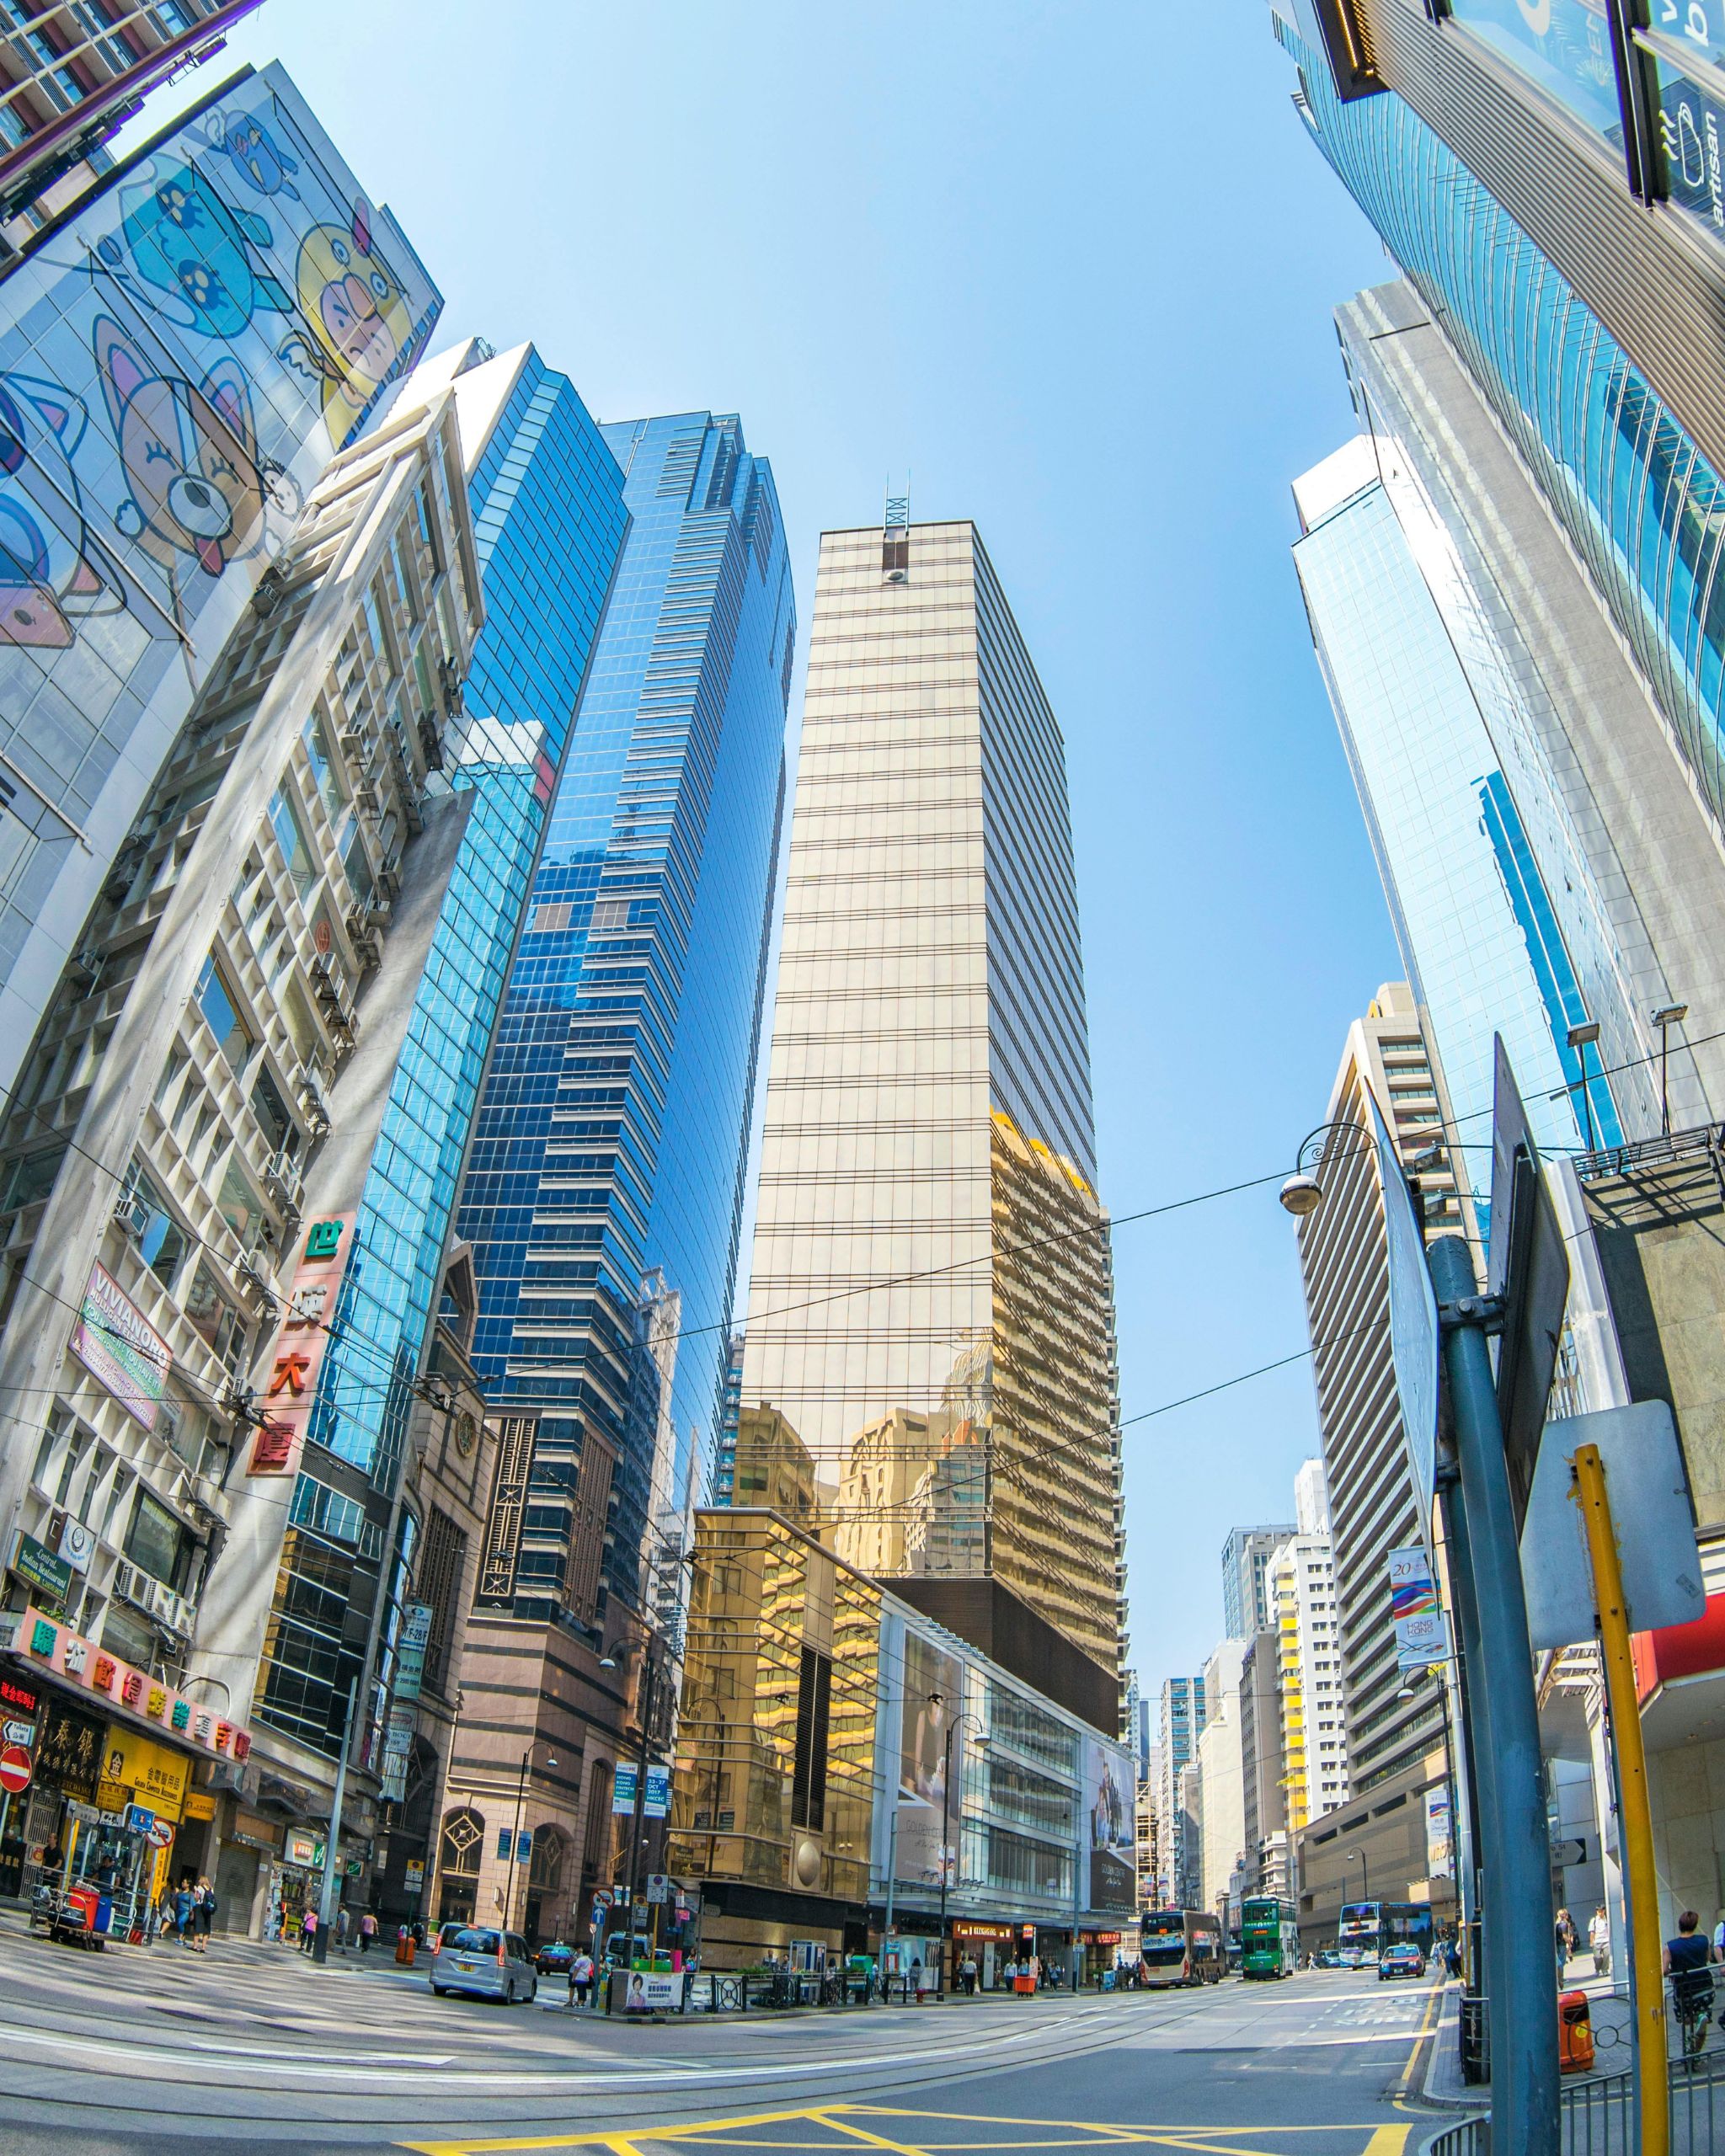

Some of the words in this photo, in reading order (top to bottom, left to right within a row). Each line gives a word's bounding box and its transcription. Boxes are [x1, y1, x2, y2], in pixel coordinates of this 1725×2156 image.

[1706, 111, 1724, 227] artisan
[96, 1268, 168, 1367] VIVIANORO
[21, 1550, 39, 1569] Indian
[39, 1564, 67, 1588] Restaurant
[37, 1549, 57, 1570] Central
[1392, 1562, 1411, 1577] 20
[1407, 1620, 1434, 1630] HONG
[1407, 1627, 1434, 1636] KONG
[110, 1753, 122, 1776] 金
